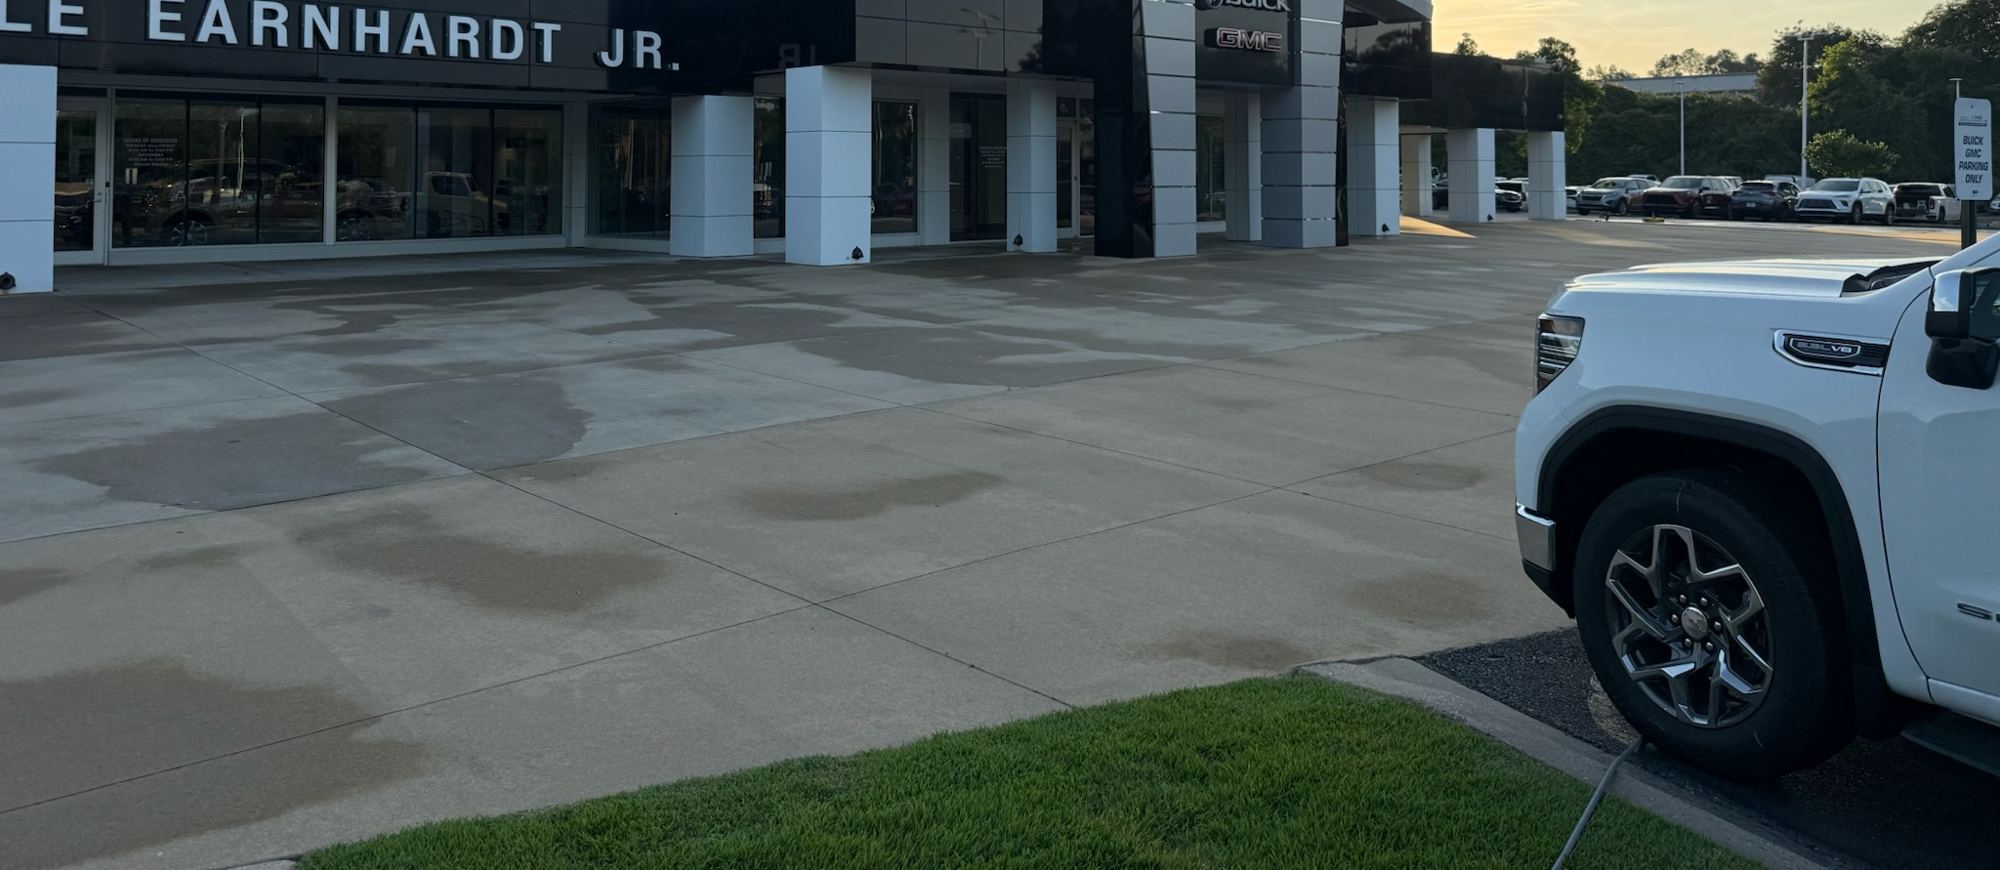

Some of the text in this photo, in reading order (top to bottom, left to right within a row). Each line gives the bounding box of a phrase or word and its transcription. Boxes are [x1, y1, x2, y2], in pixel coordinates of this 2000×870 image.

[149, 0, 561, 63] EARNHARDT
[597, 28, 680, 71] JR.
[1217, 27, 1283, 52] GMC
[1963, 135, 1984, 146] BUICK
[1965, 148, 1982, 159] GMC
[1958, 161, 1989, 171] PARKING
[1965, 174, 1983, 184] ONLY
